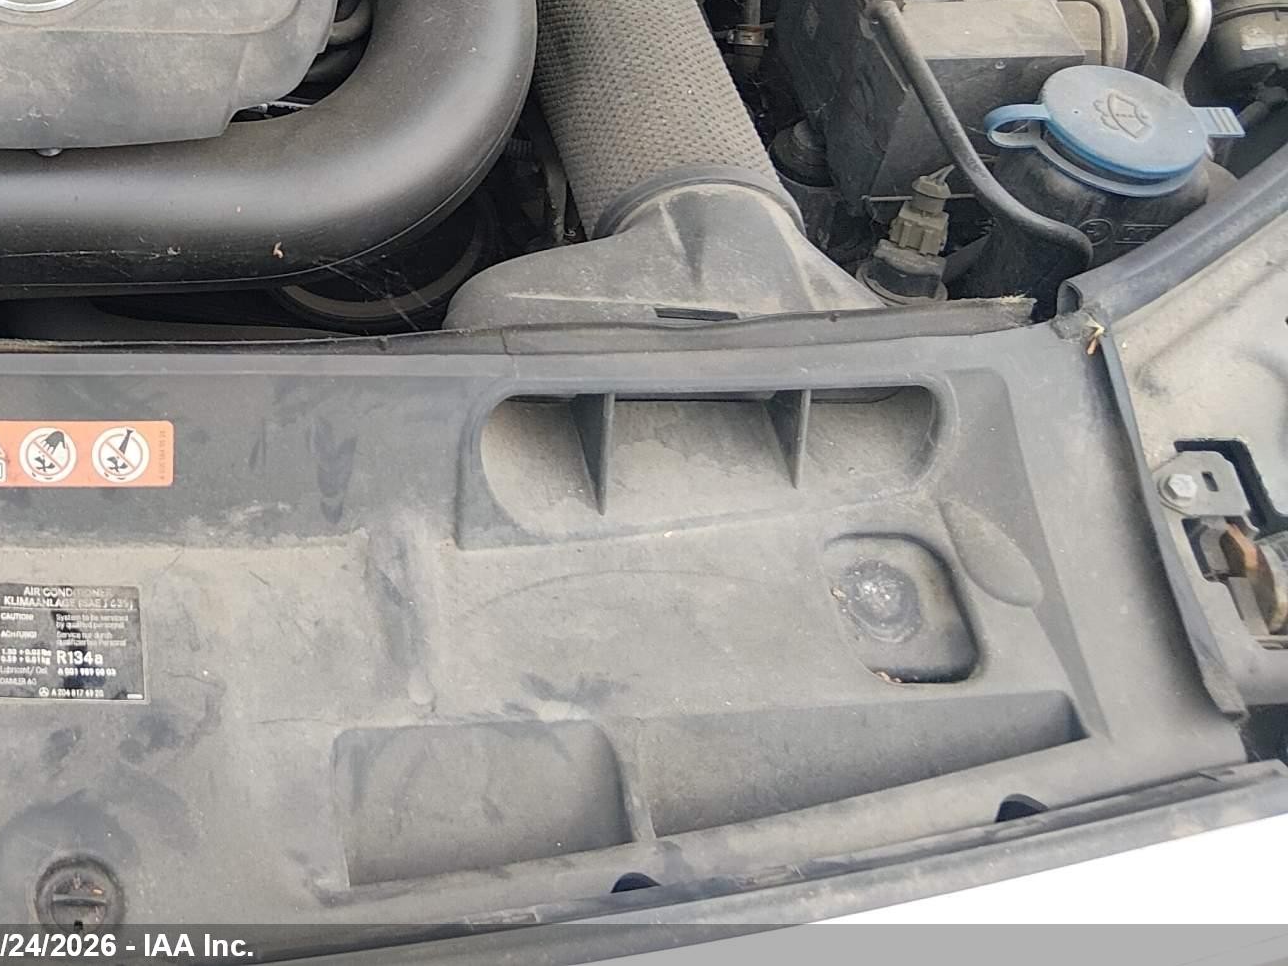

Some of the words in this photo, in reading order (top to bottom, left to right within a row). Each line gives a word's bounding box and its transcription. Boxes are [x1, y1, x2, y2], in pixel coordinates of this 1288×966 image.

[23, 585, 41, 597] AIR
[3, 595, 75, 608] KLIMAANLAGE
[56, 649, 104, 666] R134a
